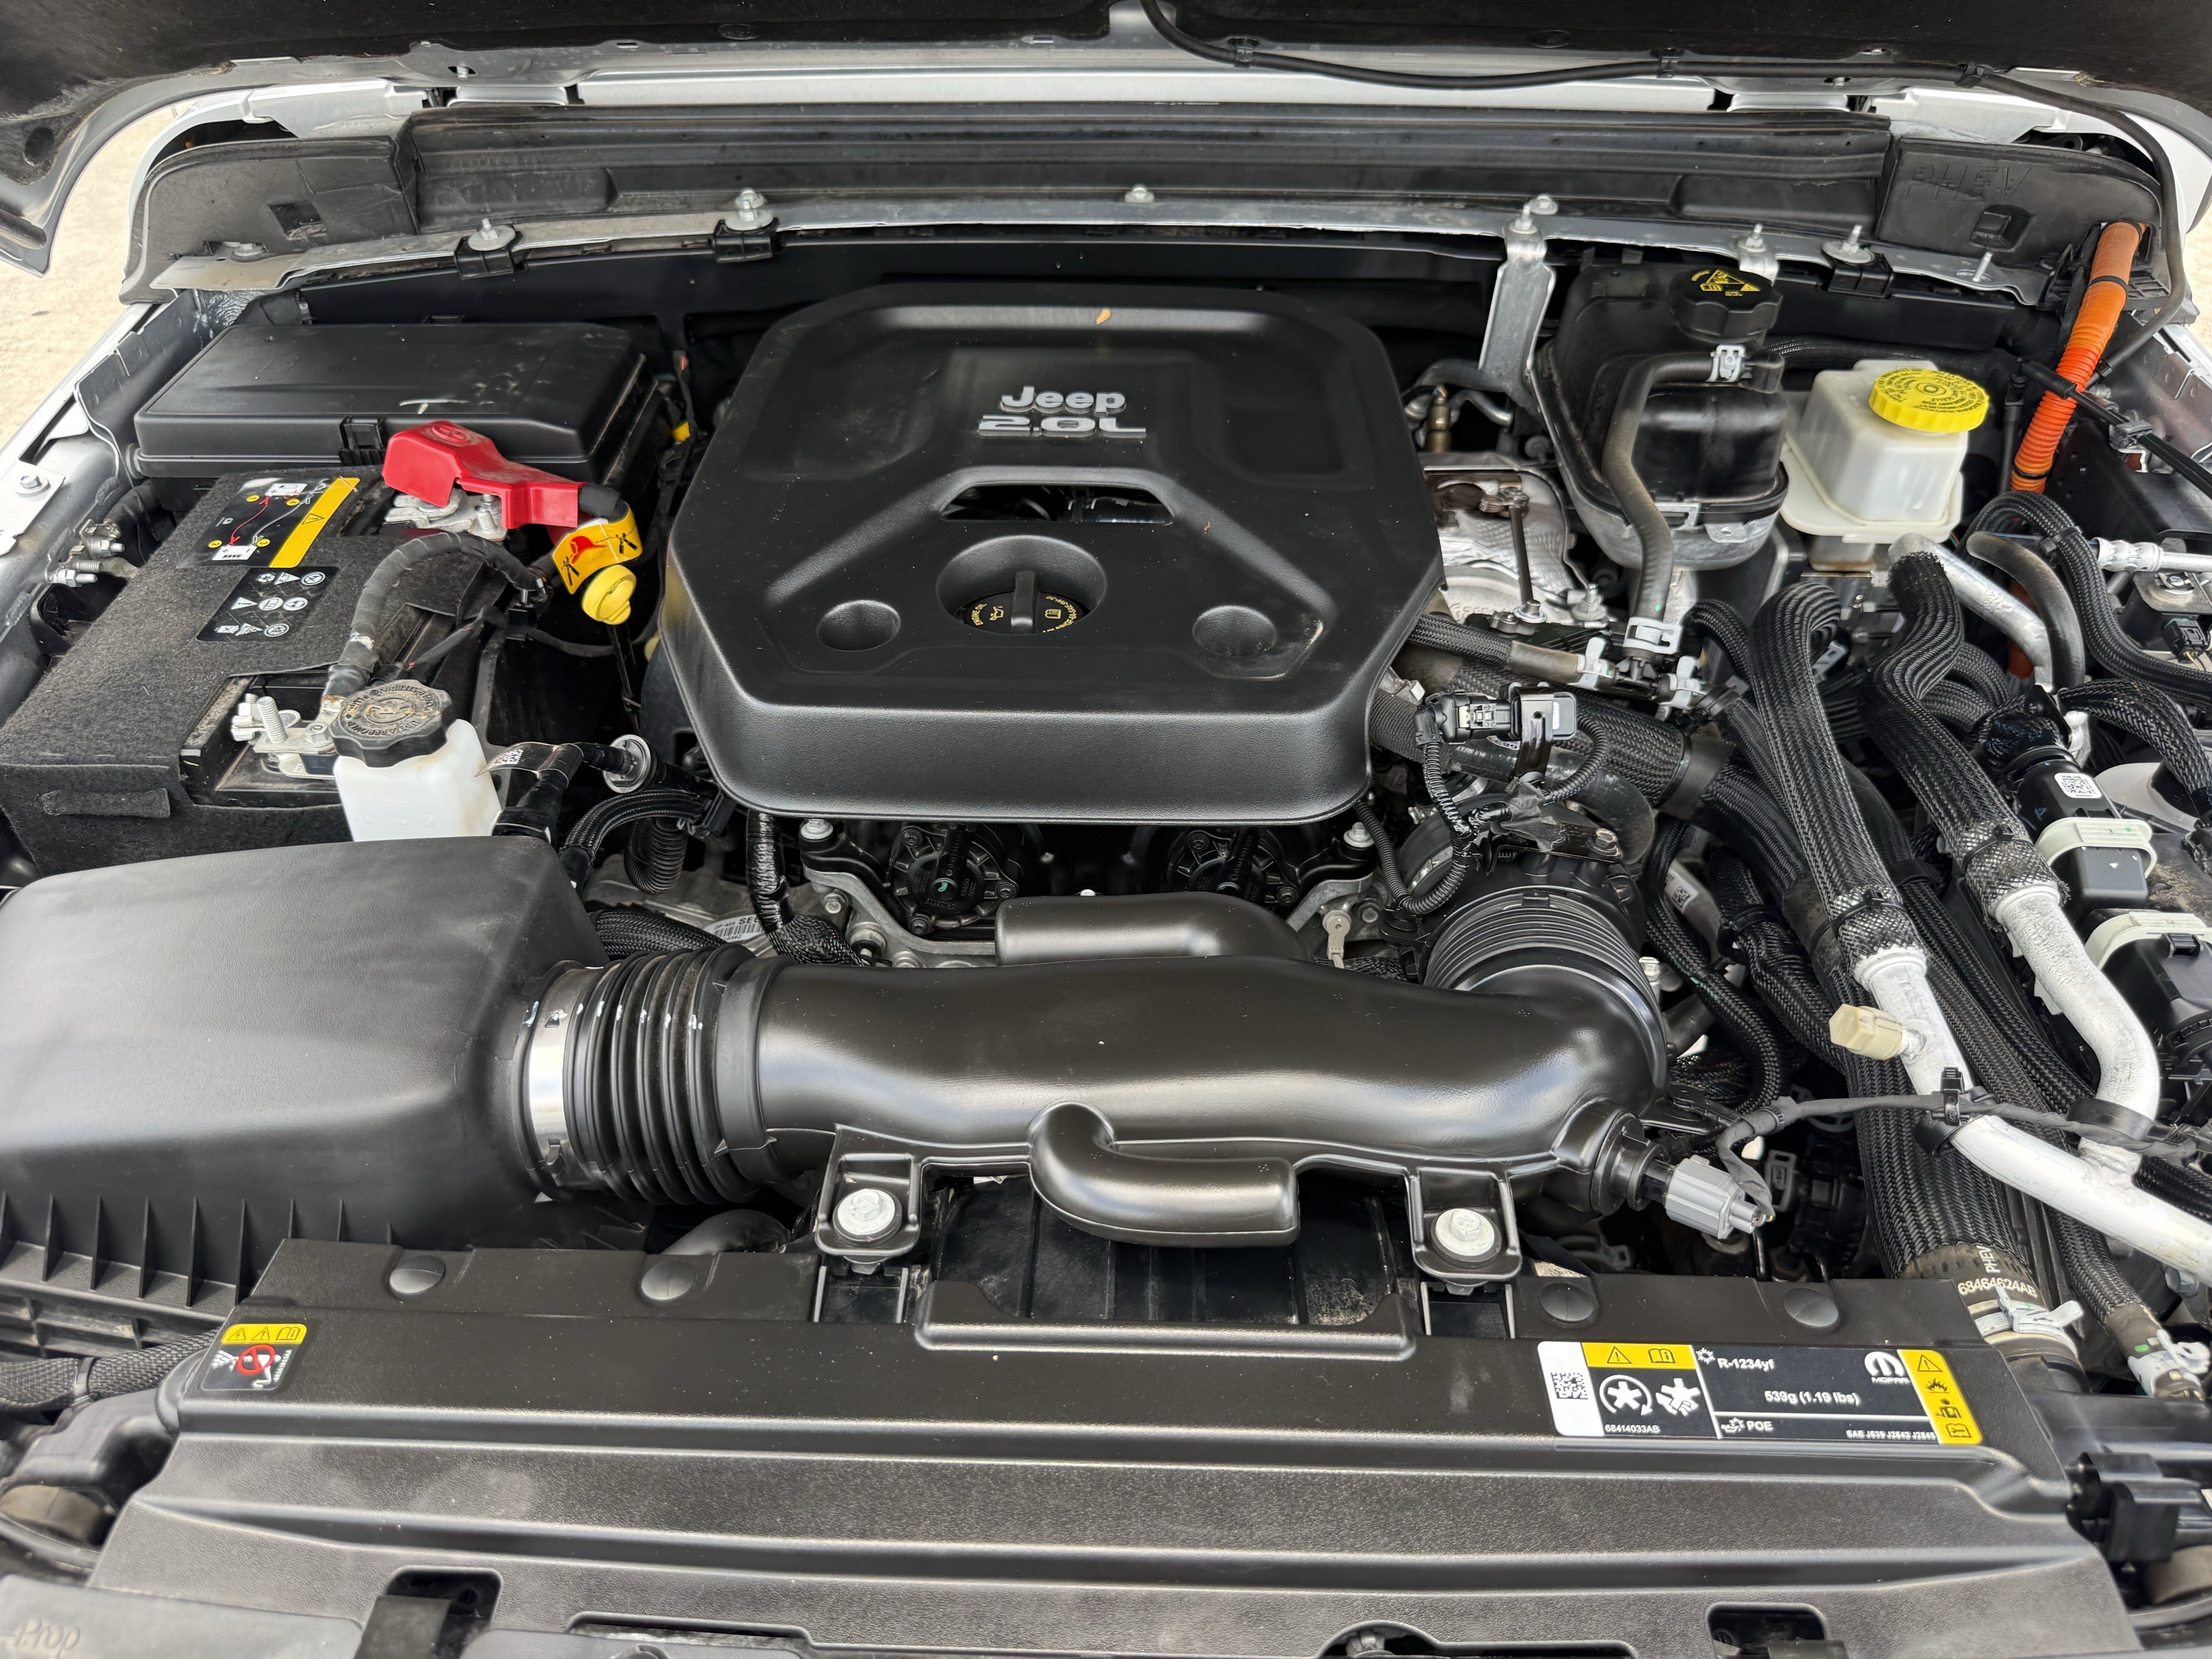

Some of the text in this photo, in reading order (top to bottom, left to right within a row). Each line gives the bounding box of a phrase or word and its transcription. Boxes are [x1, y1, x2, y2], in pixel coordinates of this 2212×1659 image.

[1906, 163, 2032, 203] PHEV
[1000, 385, 1127, 413] Jeep
[978, 414, 1147, 438] 2.0L
[971, 609, 984, 626] ENGINE
[347, 720, 421, 736] USE APPROVED
[1976, 1245, 2001, 1273] PHEV
[1717, 1358, 1775, 1372] R-1234yf
[1871, 1377, 1911, 1386] MOPAR
[1764, 1391, 1861, 1407] 539g (1.19 lbs)
[1604, 1424, 1661, 1434] 68414033AB
[1746, 1420, 1774, 1432] POE
[1846, 1430, 1865, 1439] SAE
[13, 1617, 82, 1658] Prop
